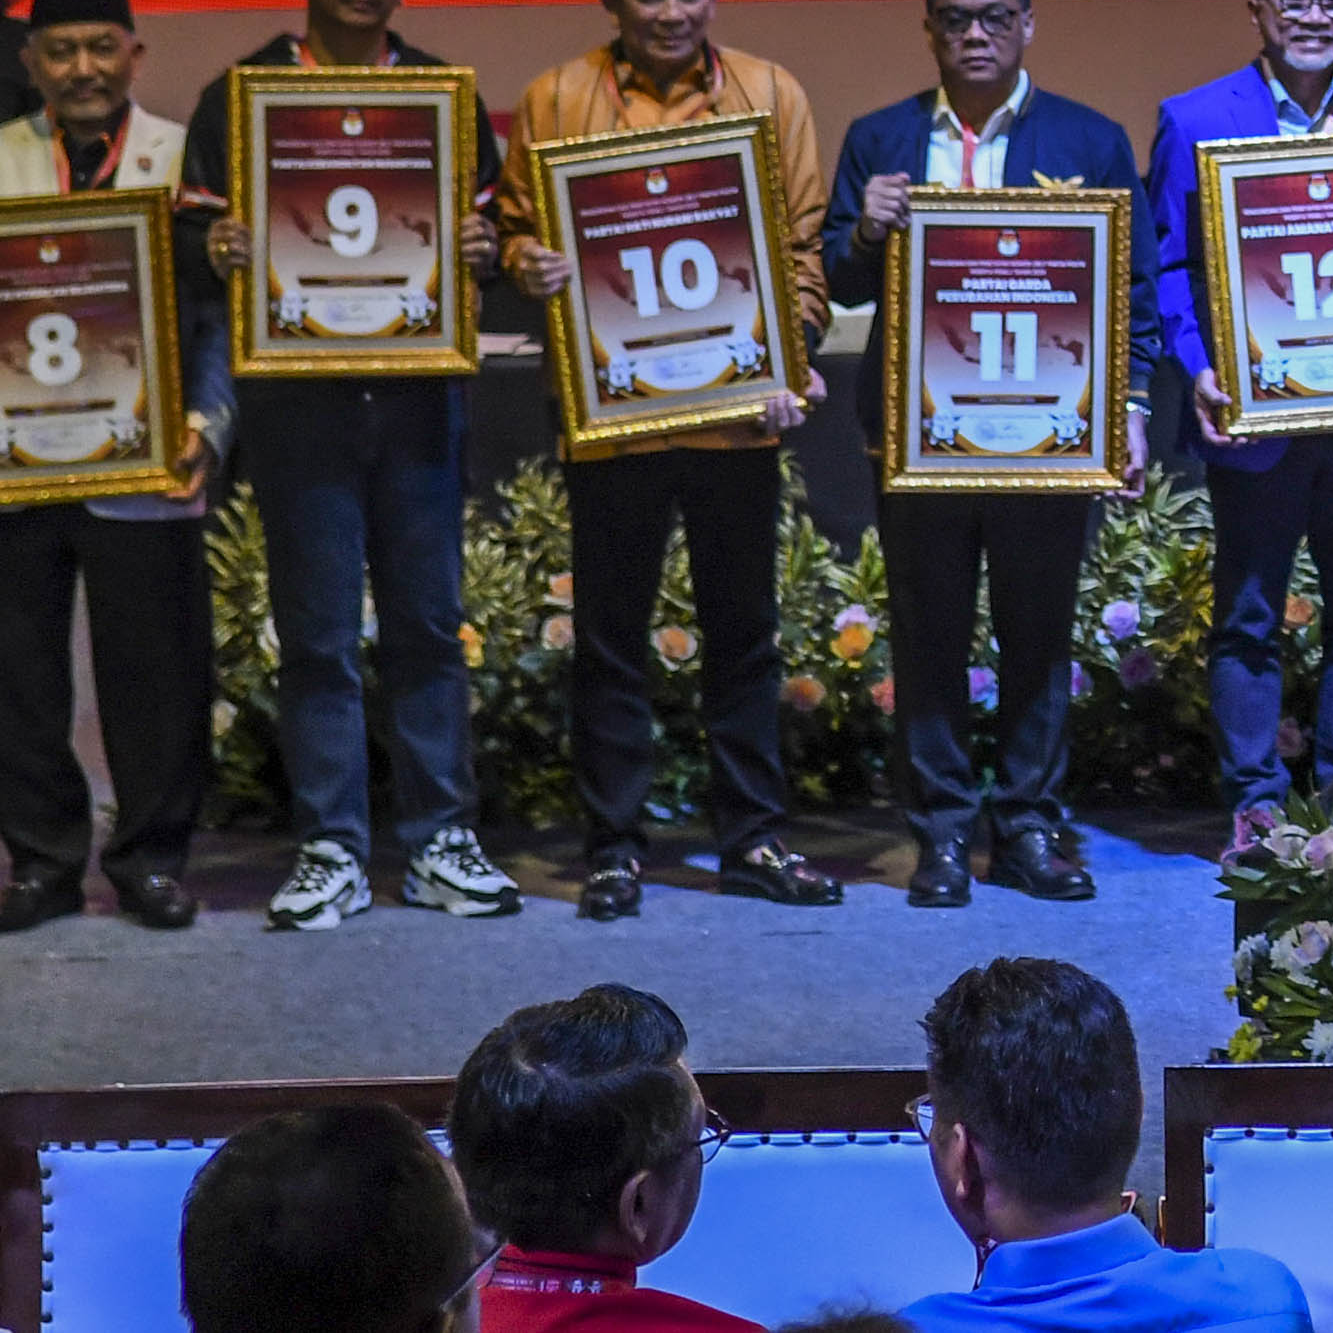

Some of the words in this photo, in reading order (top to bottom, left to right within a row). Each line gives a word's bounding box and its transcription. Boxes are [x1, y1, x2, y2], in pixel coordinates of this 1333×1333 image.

[325, 184, 379, 258] 9
[619, 238, 720, 318] 10
[27, 312, 83, 386] 8
[970, 311, 1038, 382] 11
